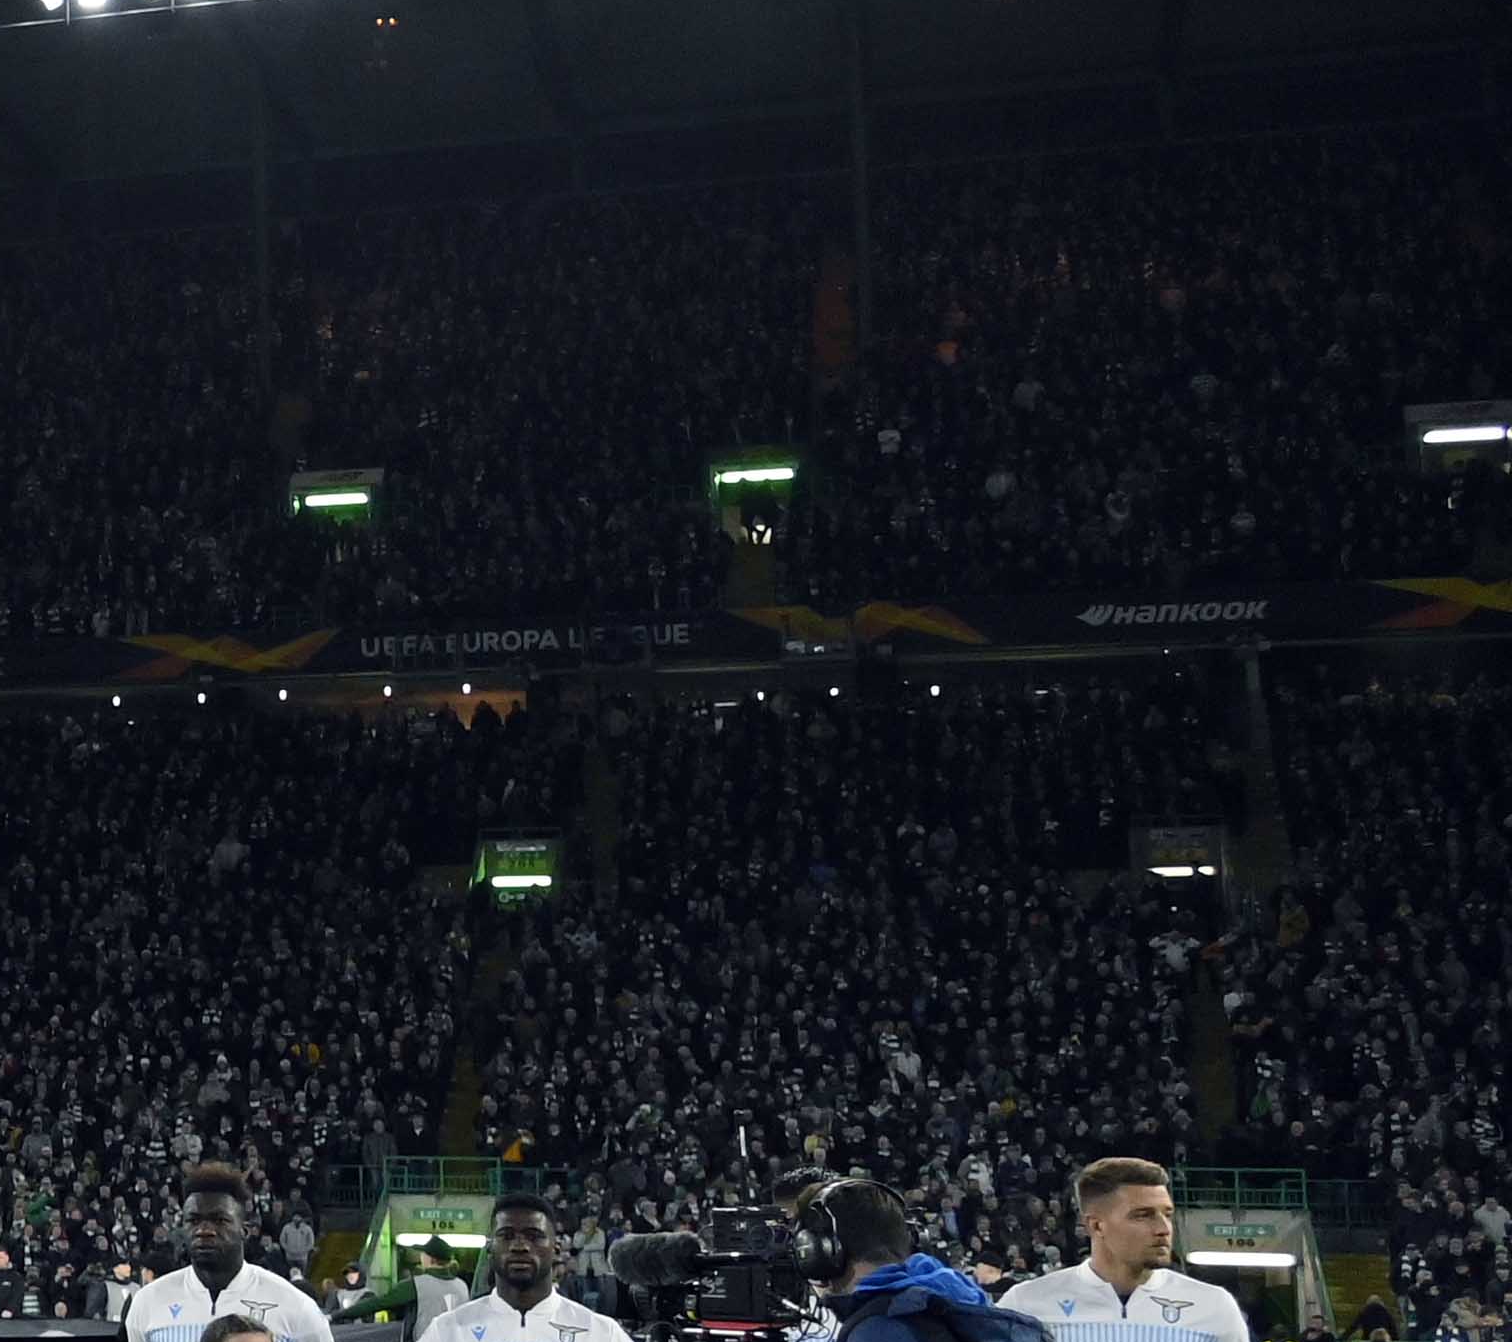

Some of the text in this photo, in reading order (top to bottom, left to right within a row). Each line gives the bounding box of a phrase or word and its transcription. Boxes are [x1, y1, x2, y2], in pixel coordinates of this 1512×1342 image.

[360, 633, 437, 658] UEFA
[445, 627, 562, 653] EUROPA
[1213, 1225, 1238, 1236] EXIT
